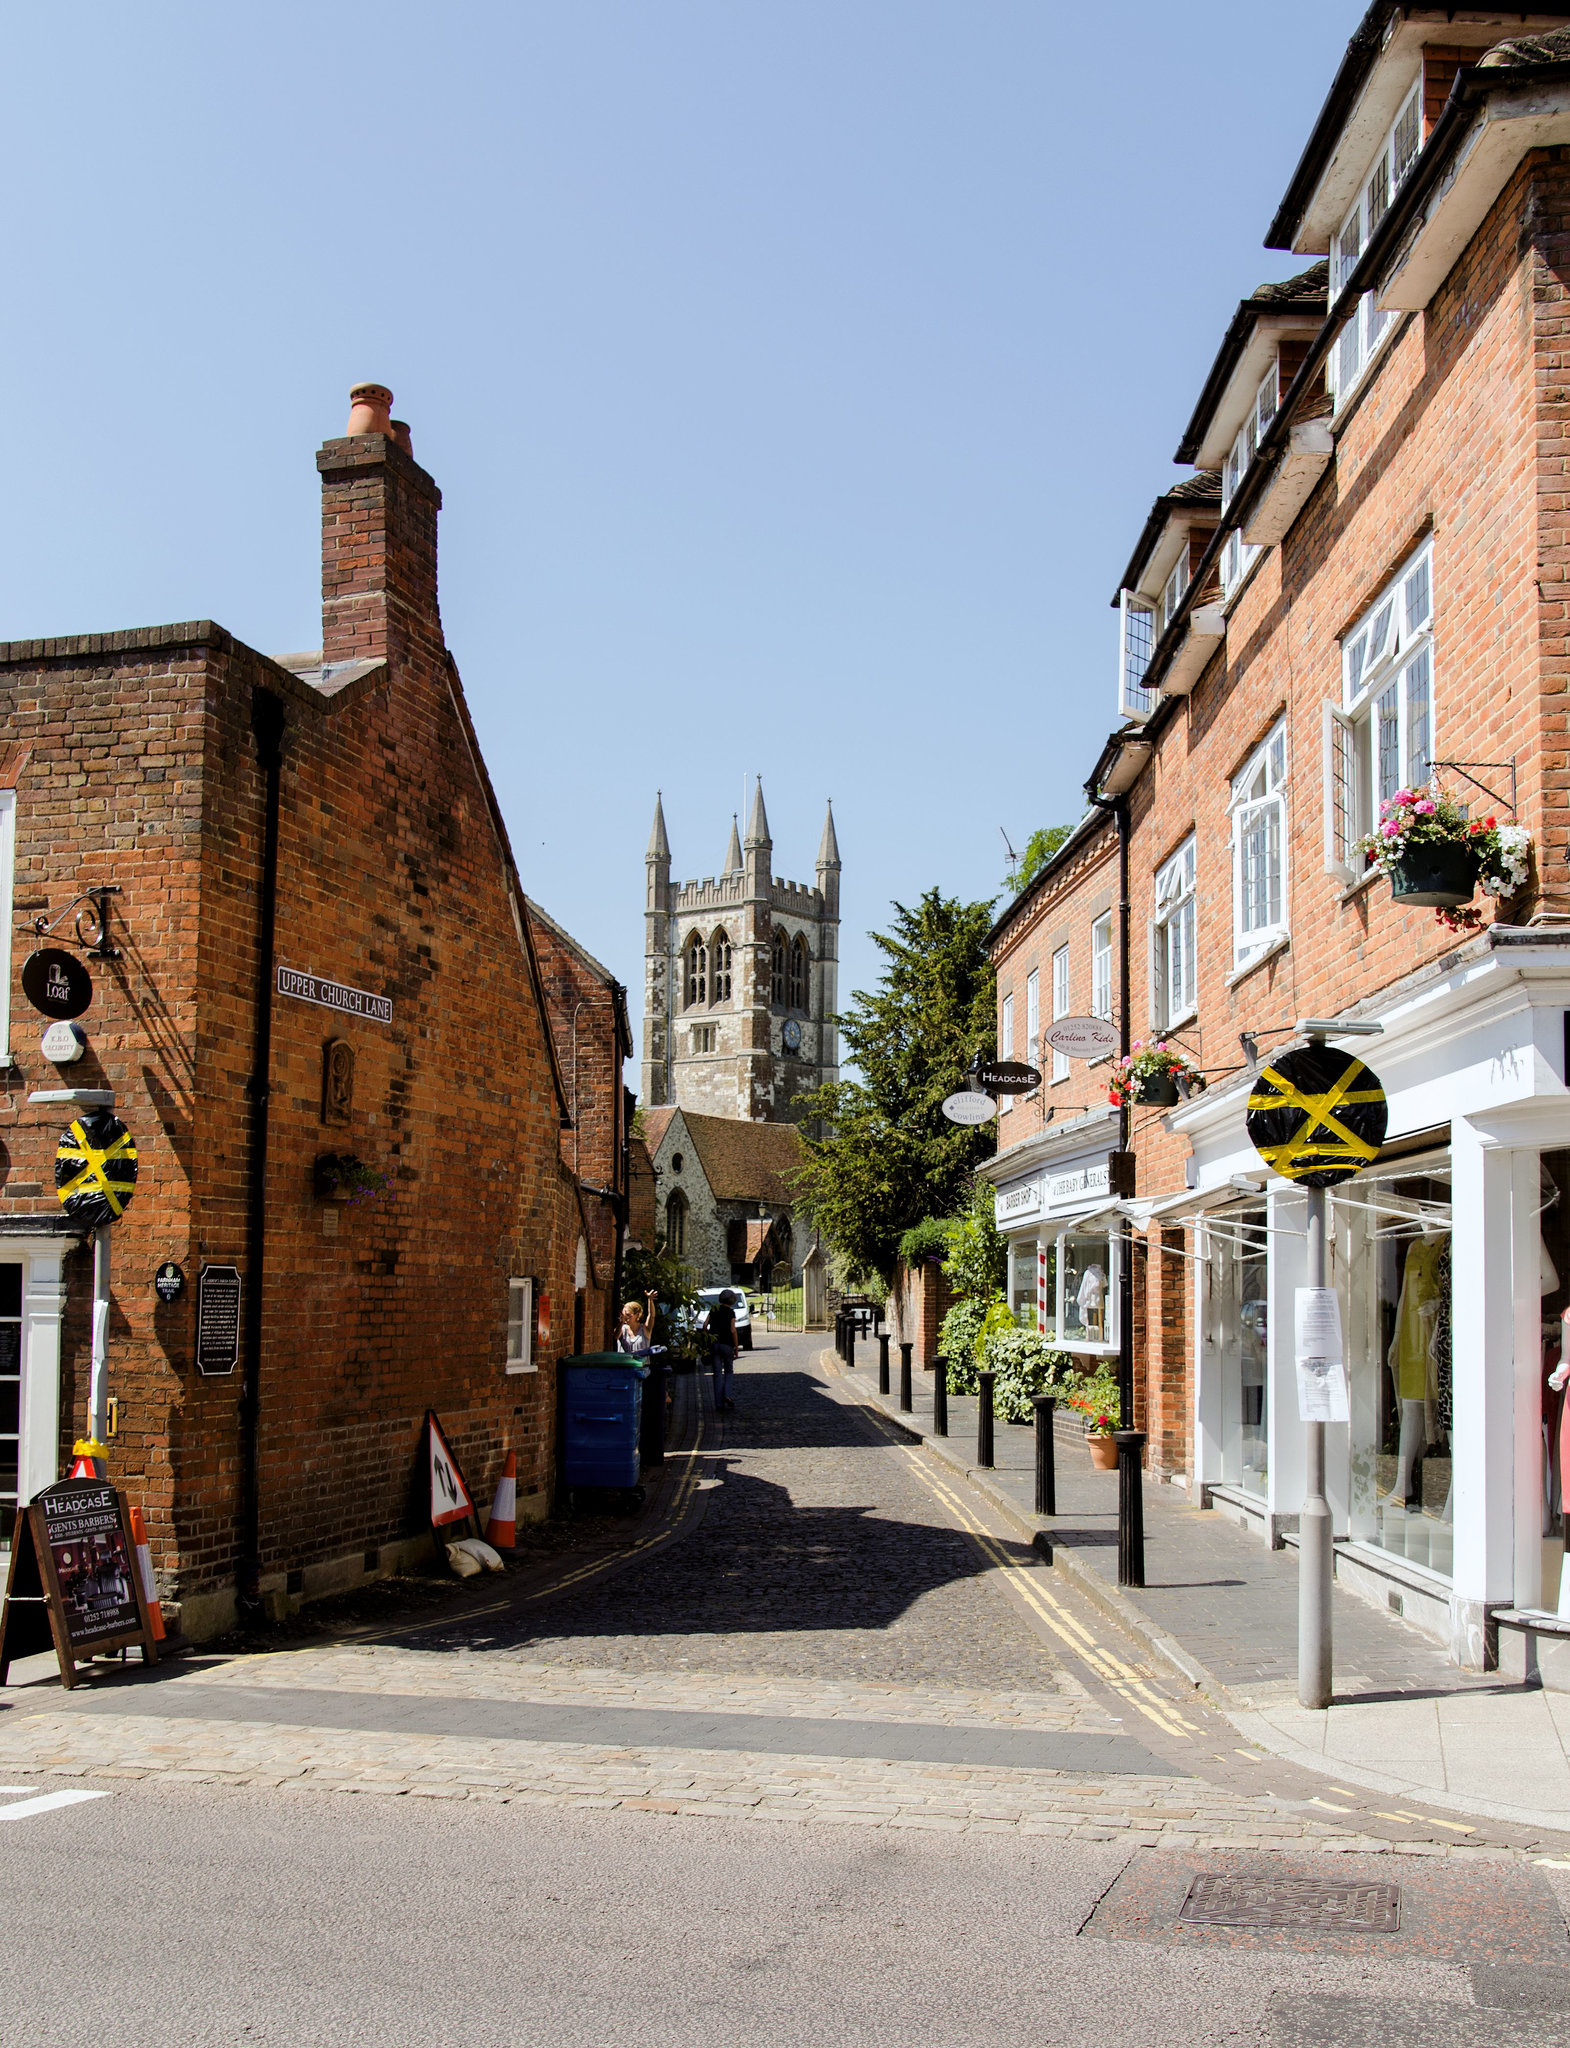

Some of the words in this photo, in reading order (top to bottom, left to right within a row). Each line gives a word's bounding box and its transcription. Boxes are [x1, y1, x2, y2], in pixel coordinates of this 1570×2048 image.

[46, 982, 71, 1000] Loaf
[282, 971, 316, 998] UPPER
[320, 984, 362, 1011] CHURCH
[365, 997, 389, 1019] LANE
[1051, 1031, 1086, 1043] Carlino
[1091, 1032, 1114, 1043] Kids
[953, 1094, 986, 1106] clifford
[953, 1112, 986, 1121] cowling
[1056, 1180, 1065, 1195] THE
[1065, 1178, 1078, 1193] BABY
[1006, 1192, 1020, 1210] BARBER
[1020, 1188, 1031, 1205] SHOP
[51, 1518, 78, 1534] GENTS
[78, 1514, 114, 1528] BARBERS
[84, 1612, 100, 1623] 01252
[71, 1617, 136, 1637] www.headcase-barbers.com
